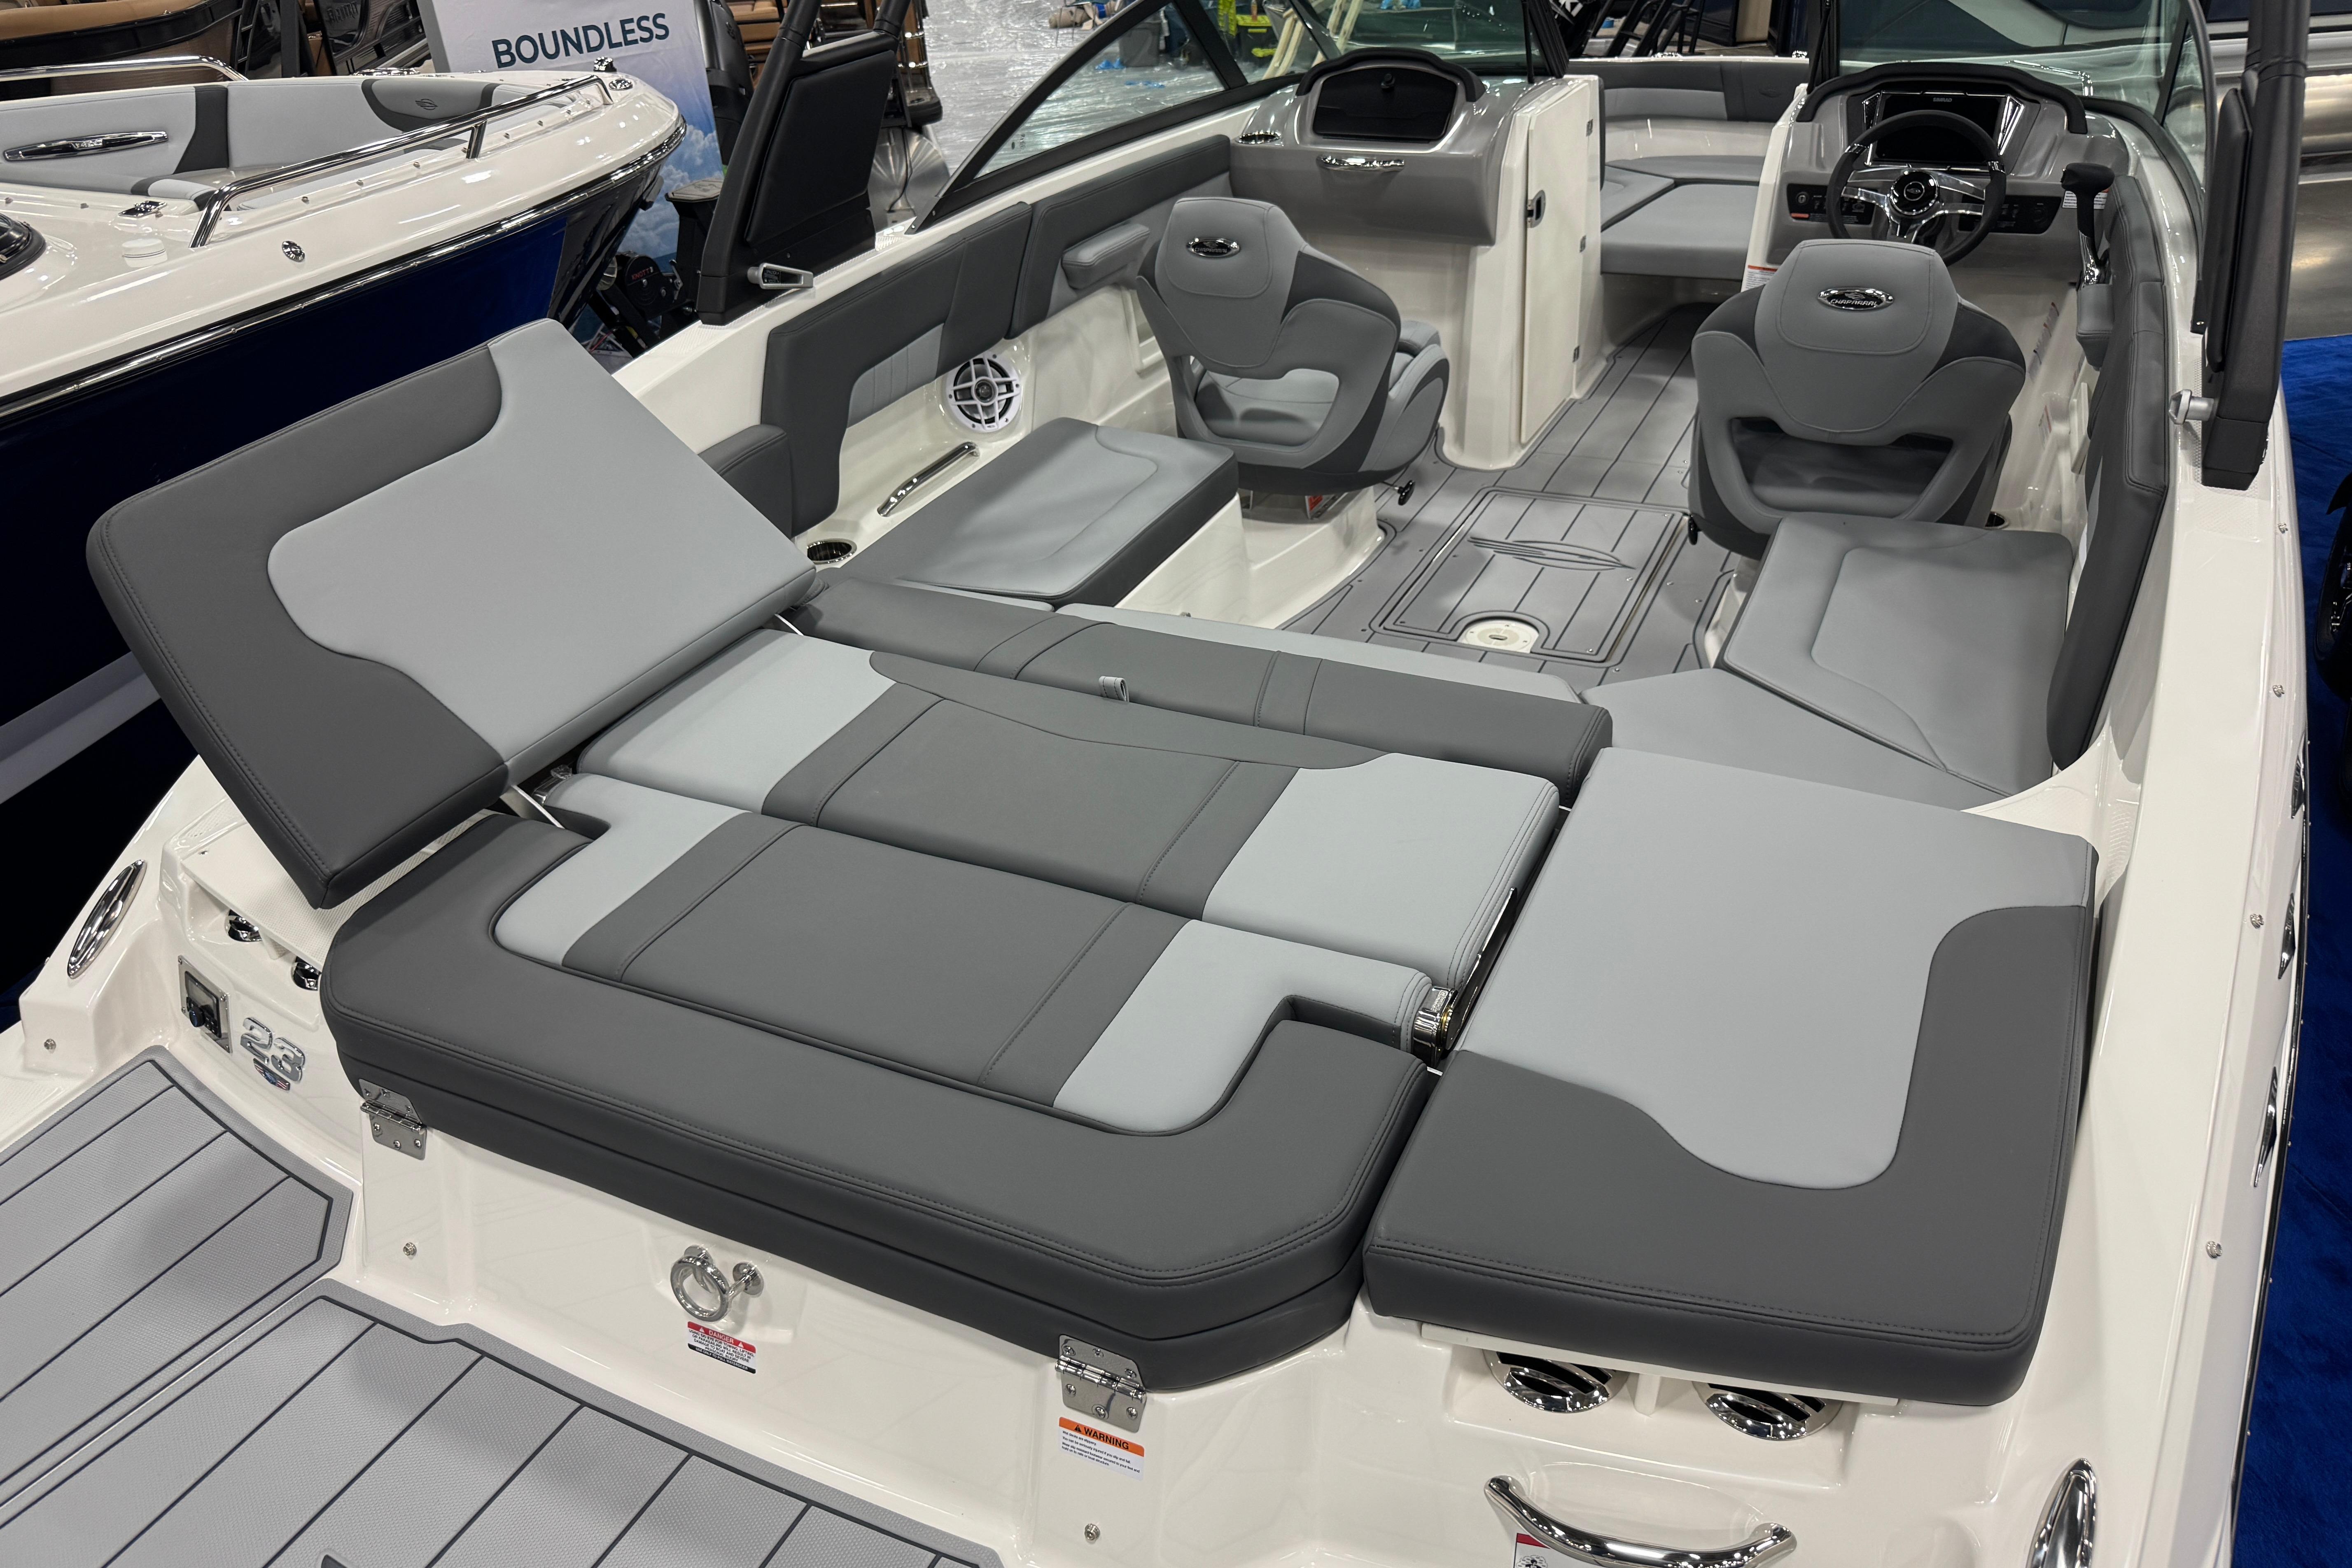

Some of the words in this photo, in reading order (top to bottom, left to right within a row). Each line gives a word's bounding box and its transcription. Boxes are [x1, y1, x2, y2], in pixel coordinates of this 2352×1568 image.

[492, 13, 670, 69] BOUNDLESS
[240, 1017, 306, 1083] 23
[709, 1330, 734, 1344] DANGER
[1084, 1426, 1129, 1450] WARNING
